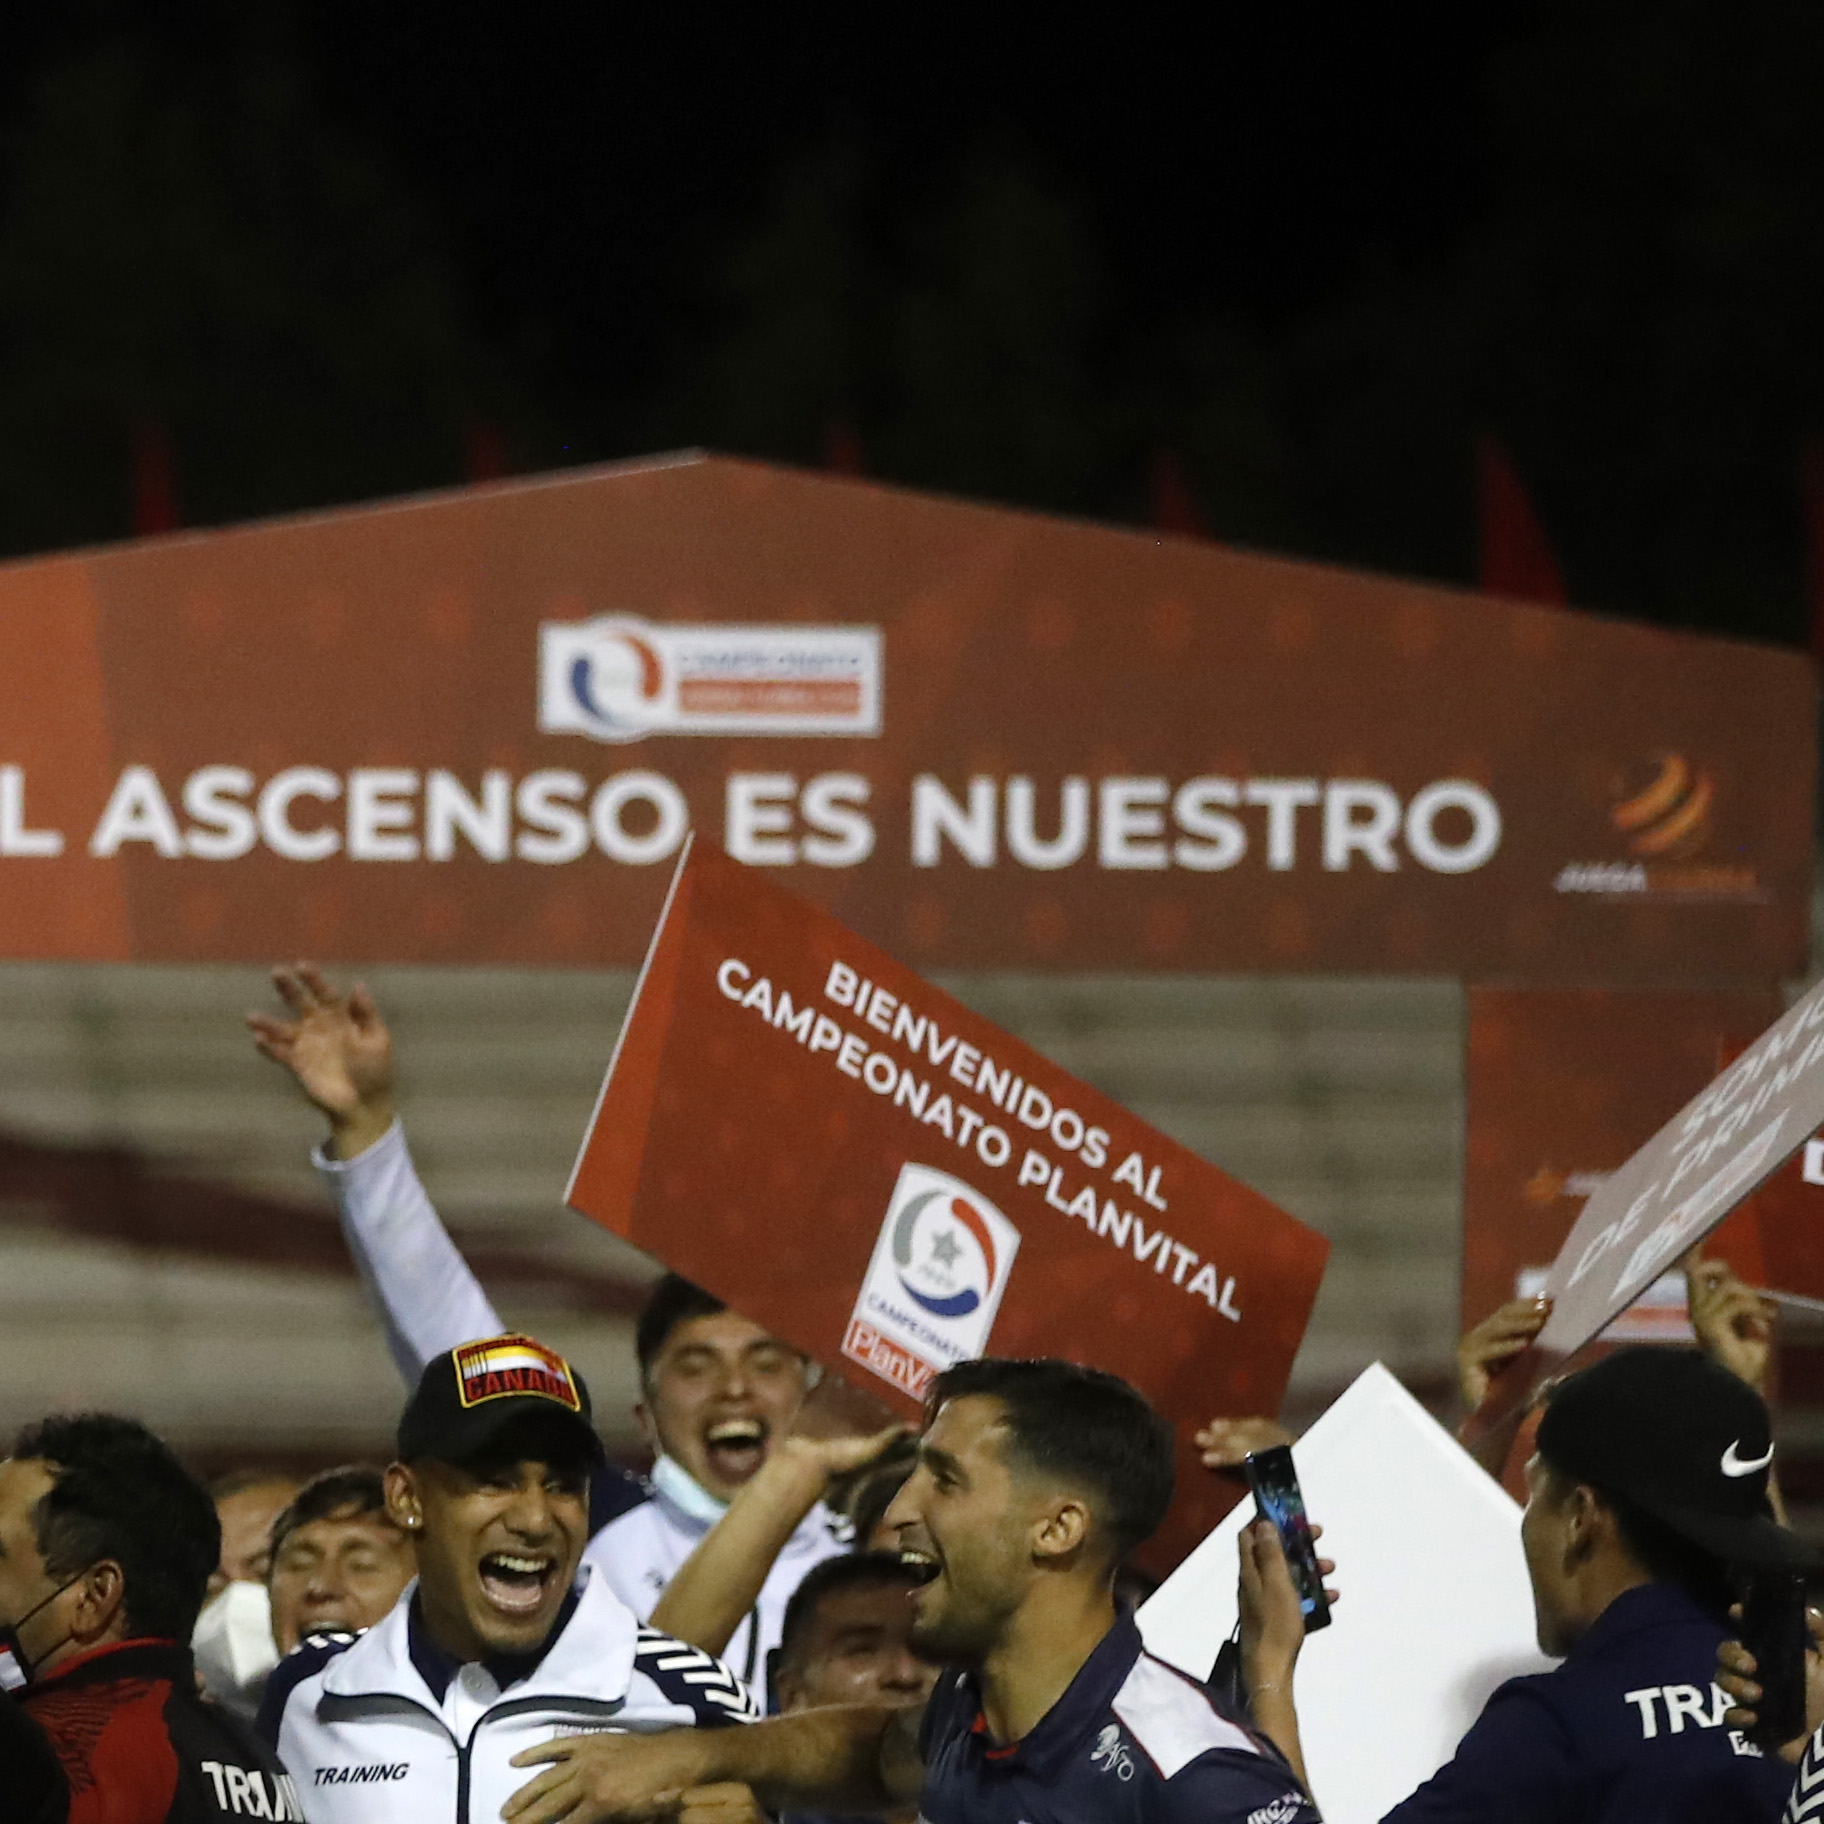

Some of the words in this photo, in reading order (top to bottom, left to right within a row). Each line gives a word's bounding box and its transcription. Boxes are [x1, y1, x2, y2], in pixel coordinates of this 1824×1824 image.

[91, 766, 690, 866] ASCENSO
[726, 774, 875, 866] ES
[912, 776, 1500, 872] NUESTRO
[824, 960, 1110, 1168] BIENVENIDOS
[1112, 1152, 1169, 1212] AL
[716, 958, 1012, 1168] CAMPEONATO
[1017, 1147, 1241, 1323] PLANVITAL
[852, 1322, 937, 1397] PlanV
[313, 1762, 410, 1787] TRAINING
